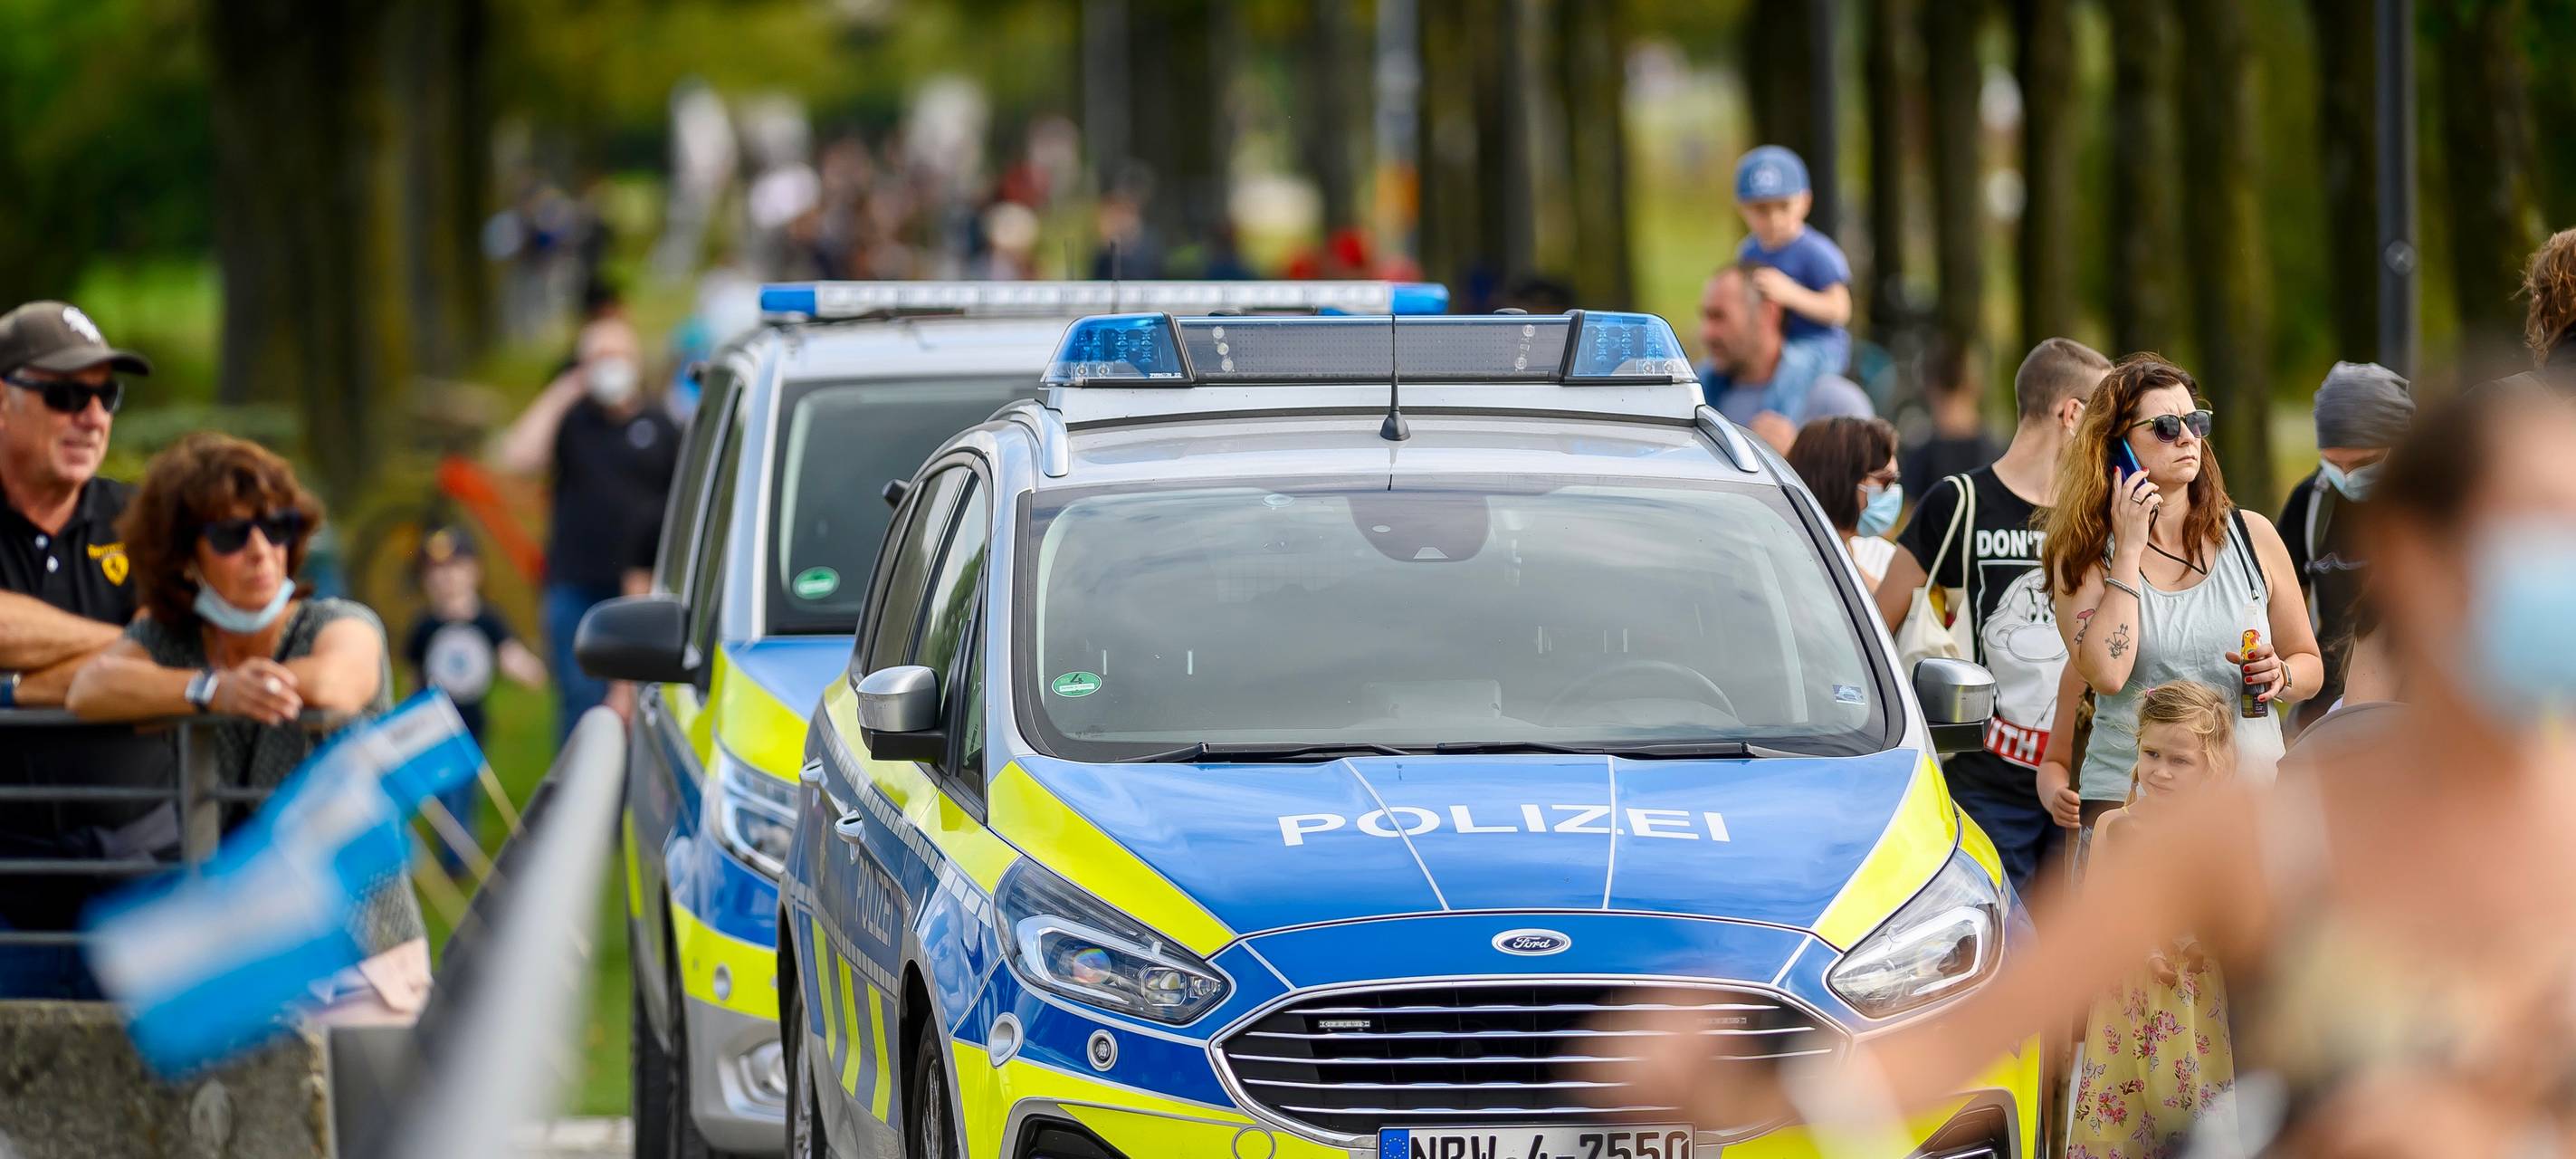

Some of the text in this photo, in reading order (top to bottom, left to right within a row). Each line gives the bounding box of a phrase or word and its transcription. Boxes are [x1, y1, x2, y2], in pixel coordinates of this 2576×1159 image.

[1070, 673, 1084, 685] 4
[1987, 717, 2038, 761] ITH
[1277, 803, 1731, 847] POLIZEI
[855, 855, 893, 947] POLIZEI
[1512, 935, 1550, 949] Ford
